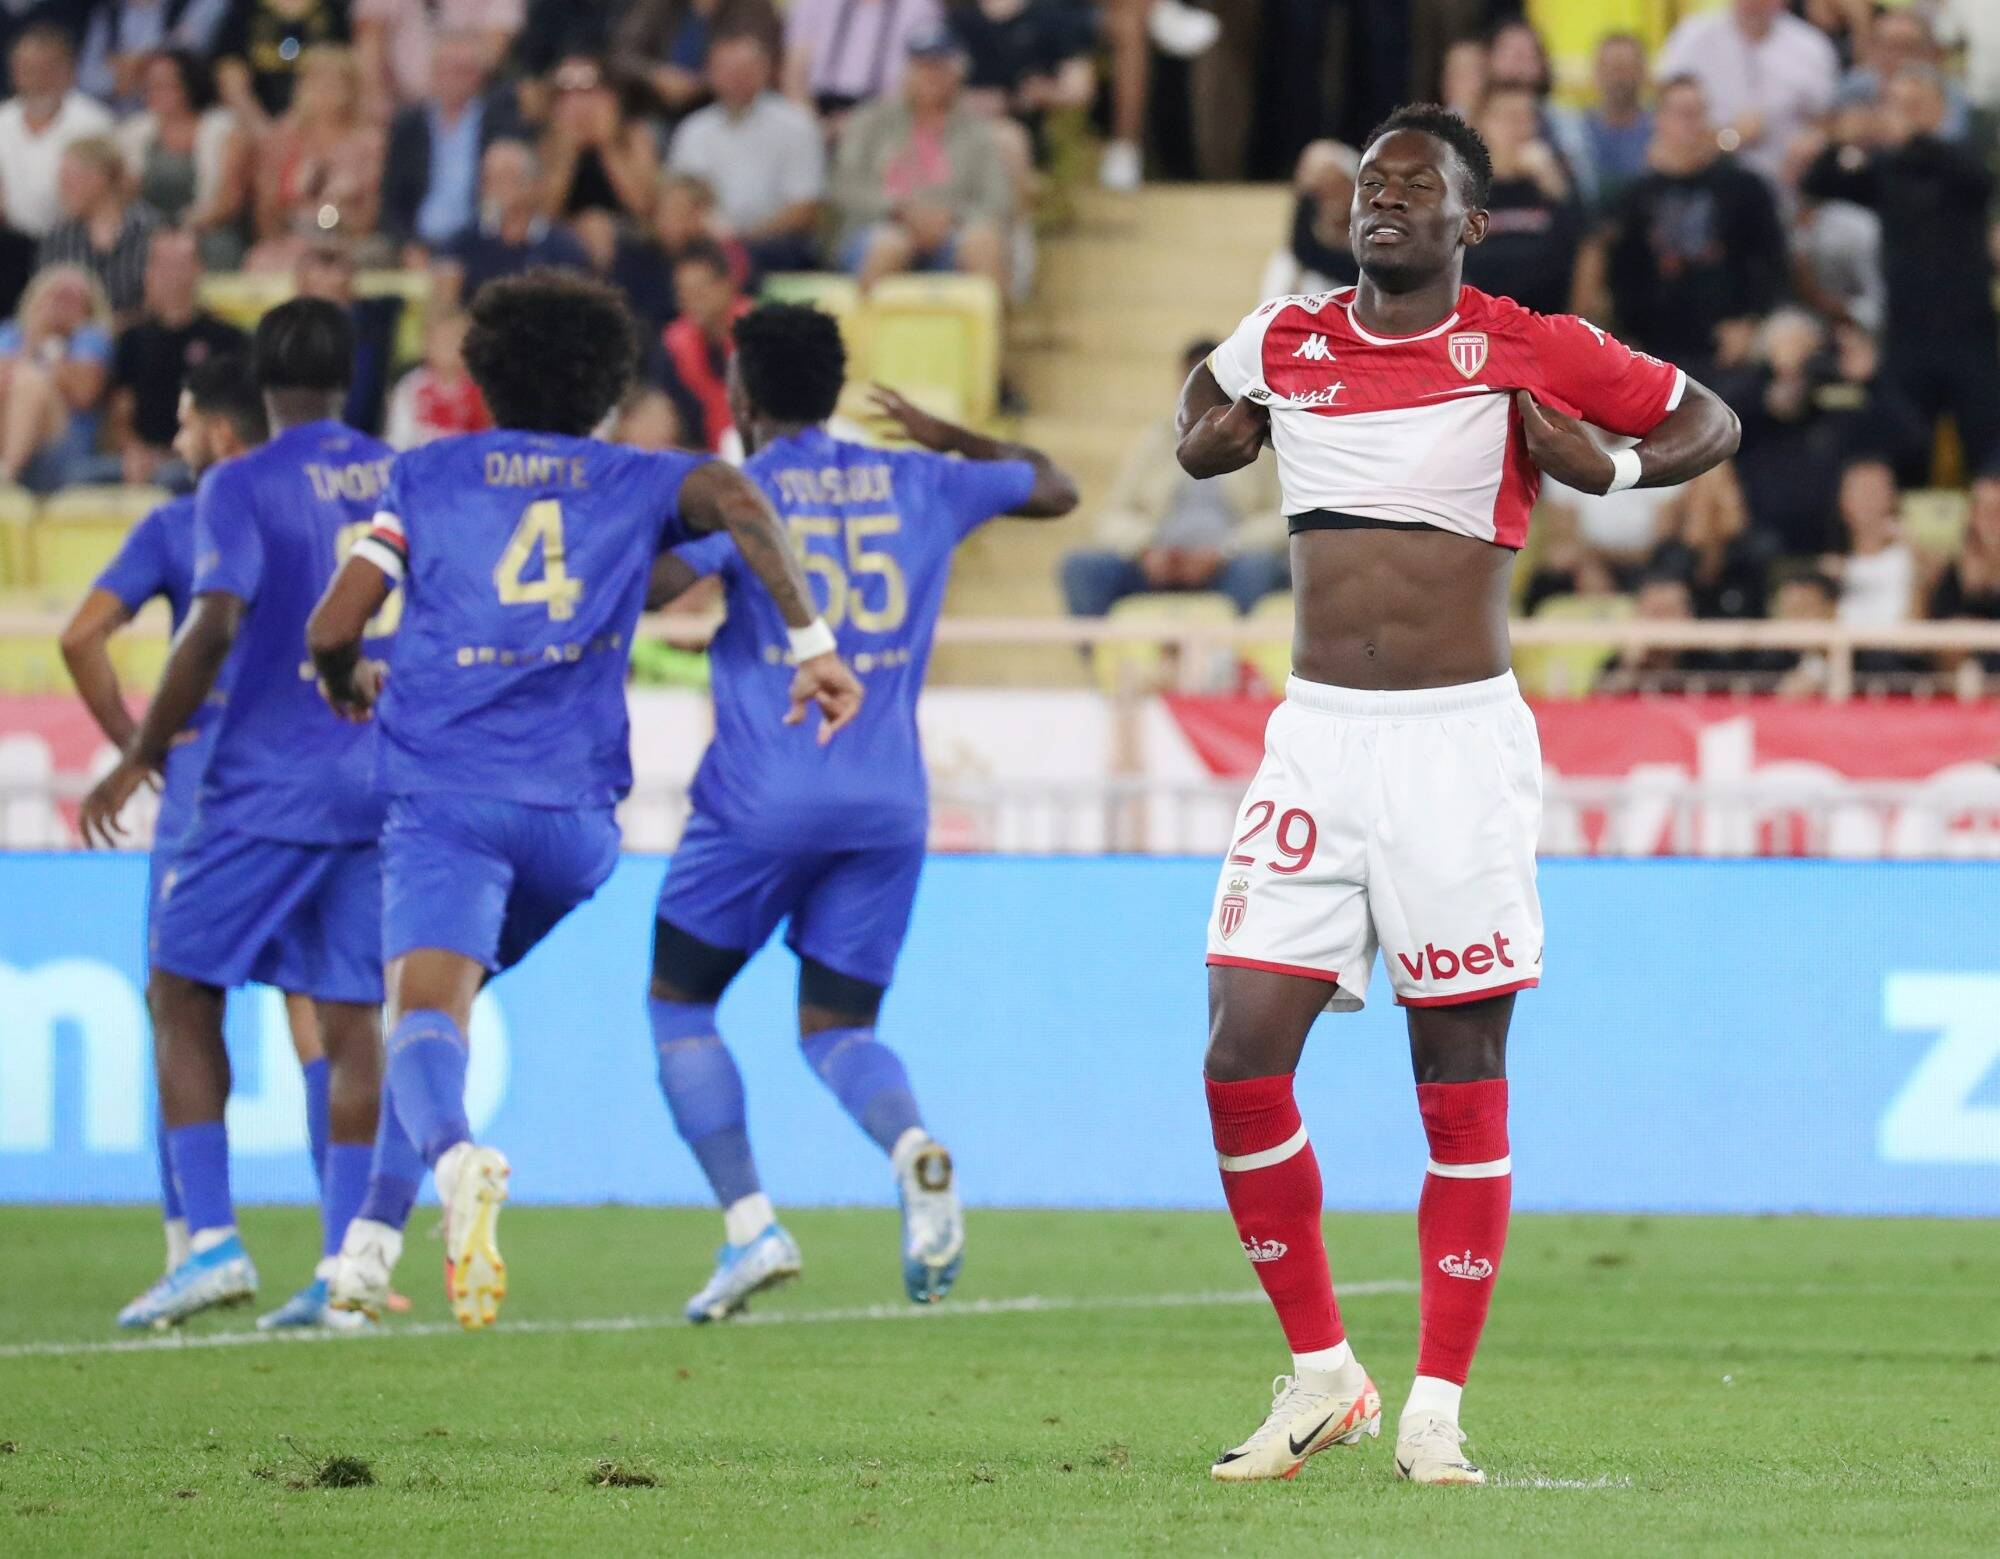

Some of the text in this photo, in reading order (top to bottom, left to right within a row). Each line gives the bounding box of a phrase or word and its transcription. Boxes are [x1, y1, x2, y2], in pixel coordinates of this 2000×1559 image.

[1289, 381, 1347, 405] visit
[484, 451, 589, 488] DANTE
[494, 498, 583, 621] 4
[785, 512, 908, 634] 55
[1228, 799, 1318, 875] 29
[1398, 930, 1515, 981] vbet
